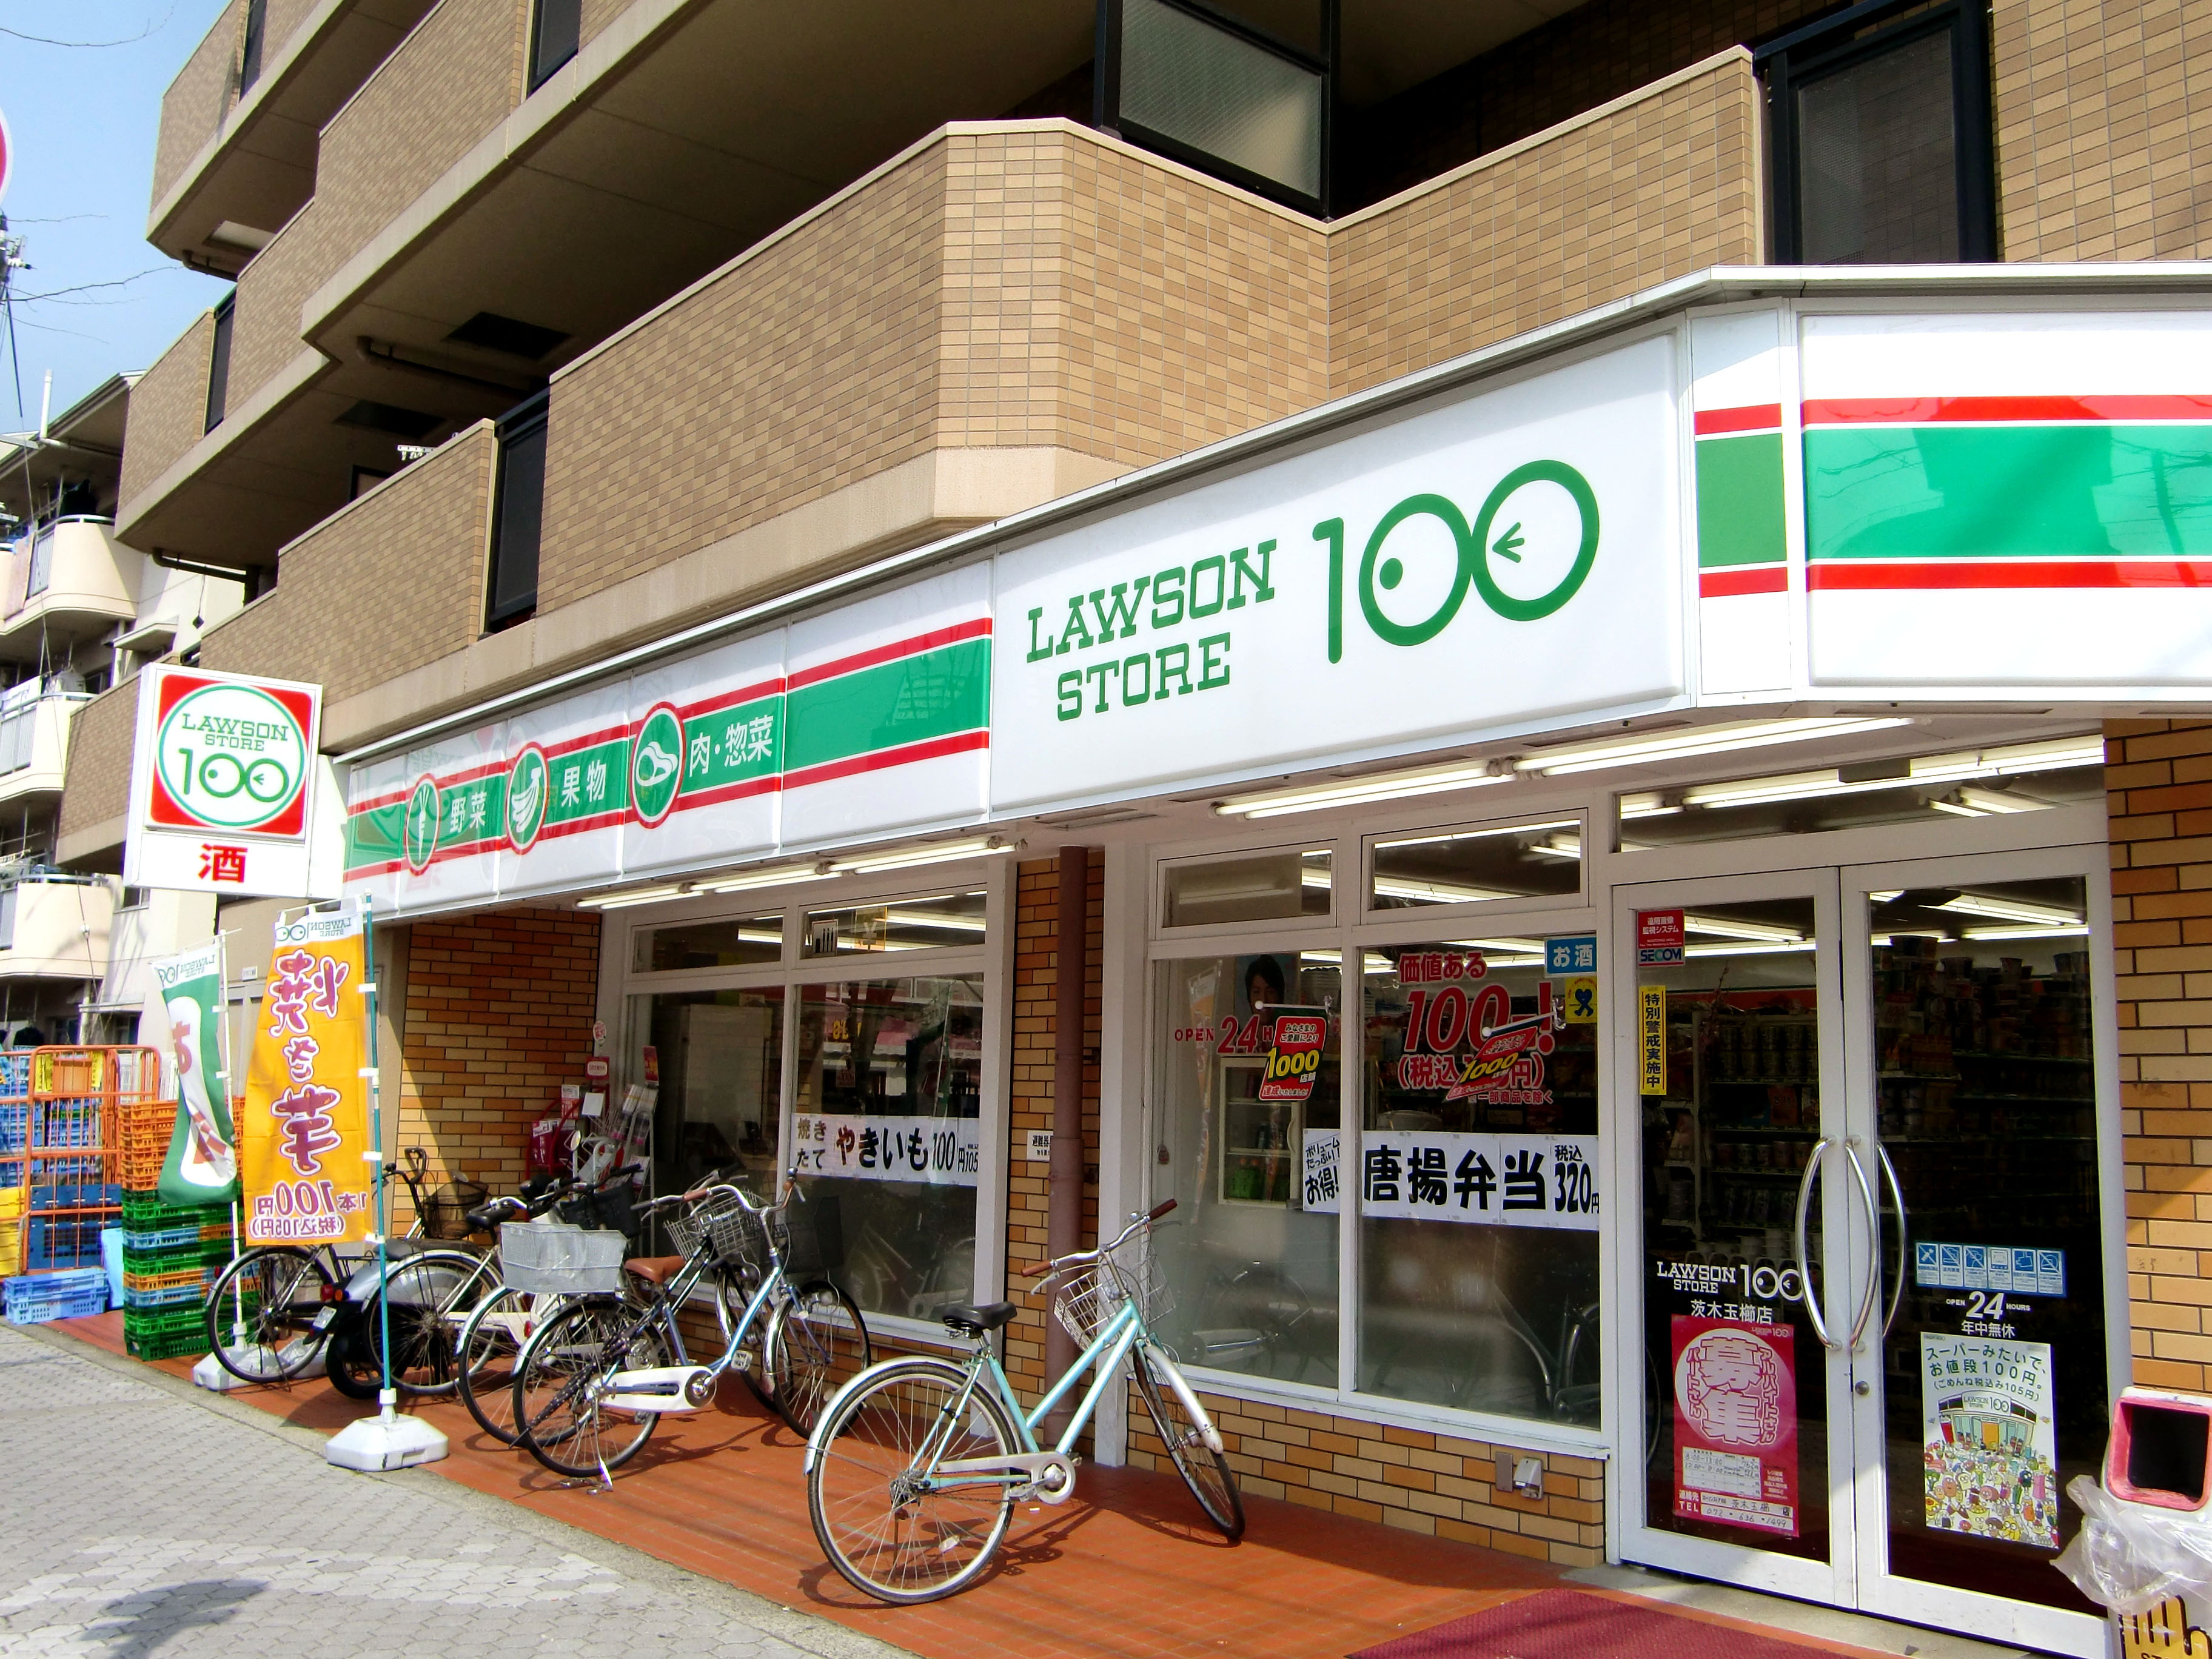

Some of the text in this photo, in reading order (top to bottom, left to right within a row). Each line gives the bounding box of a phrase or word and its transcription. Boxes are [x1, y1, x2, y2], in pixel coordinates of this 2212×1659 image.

[1312, 459, 1600, 664] 100
[1026, 538, 1277, 663] LAWSON
[1057, 632, 1230, 722] STORE
[181, 713, 289, 742] LAWSON
[205, 734, 265, 752] STORE
[689, 714, 774, 777] 肉・惣菜
[178, 748, 289, 803] 100
[560, 760, 606, 808] 果物
[449, 791, 488, 833] 野菜
[198, 843, 249, 883] 酒
[1398, 950, 1487, 984] 価値ある
[1553, 944, 1594, 968] お酒
[1640, 948, 1681, 962] SECOM
[1175, 1028, 1215, 1042] OPEN
[1216, 1014, 1260, 1054] 24
[1644, 993, 1661, 1088] 特別警戒実施中
[1267, 1047, 1320, 1079] 1000
[1459, 1052, 1519, 1084] 1000
[797, 1119, 826, 1141] 焼き
[797, 1147, 826, 1169] たて
[836, 1124, 928, 1171] やきいも
[1305, 1136, 1340, 1158] ボリューム
[1554, 1144, 1583, 1162] 税込
[1364, 1144, 1546, 1211] 唐揚弁当
[1657, 1261, 1736, 1284] LAWSON
[1674, 1279, 1718, 1294] STORE
[1740, 1264, 1805, 1301] 100
[1691, 1299, 1773, 1326] 茨木玉櫛店
[1966, 1290, 2005, 1320] 24
[2006, 1303, 2031, 1312] HOURS
[1961, 1319, 2016, 1339] 年中無休
[1925, 1342, 2046, 1374] スーパーみたいで、
[1698, 1336, 1763, 1446] 募集
[1963, 1396, 1989, 1404] LAWSON
[1989, 1396, 2009, 1413] 100
[1679, 1501, 1698, 1512] TEL
